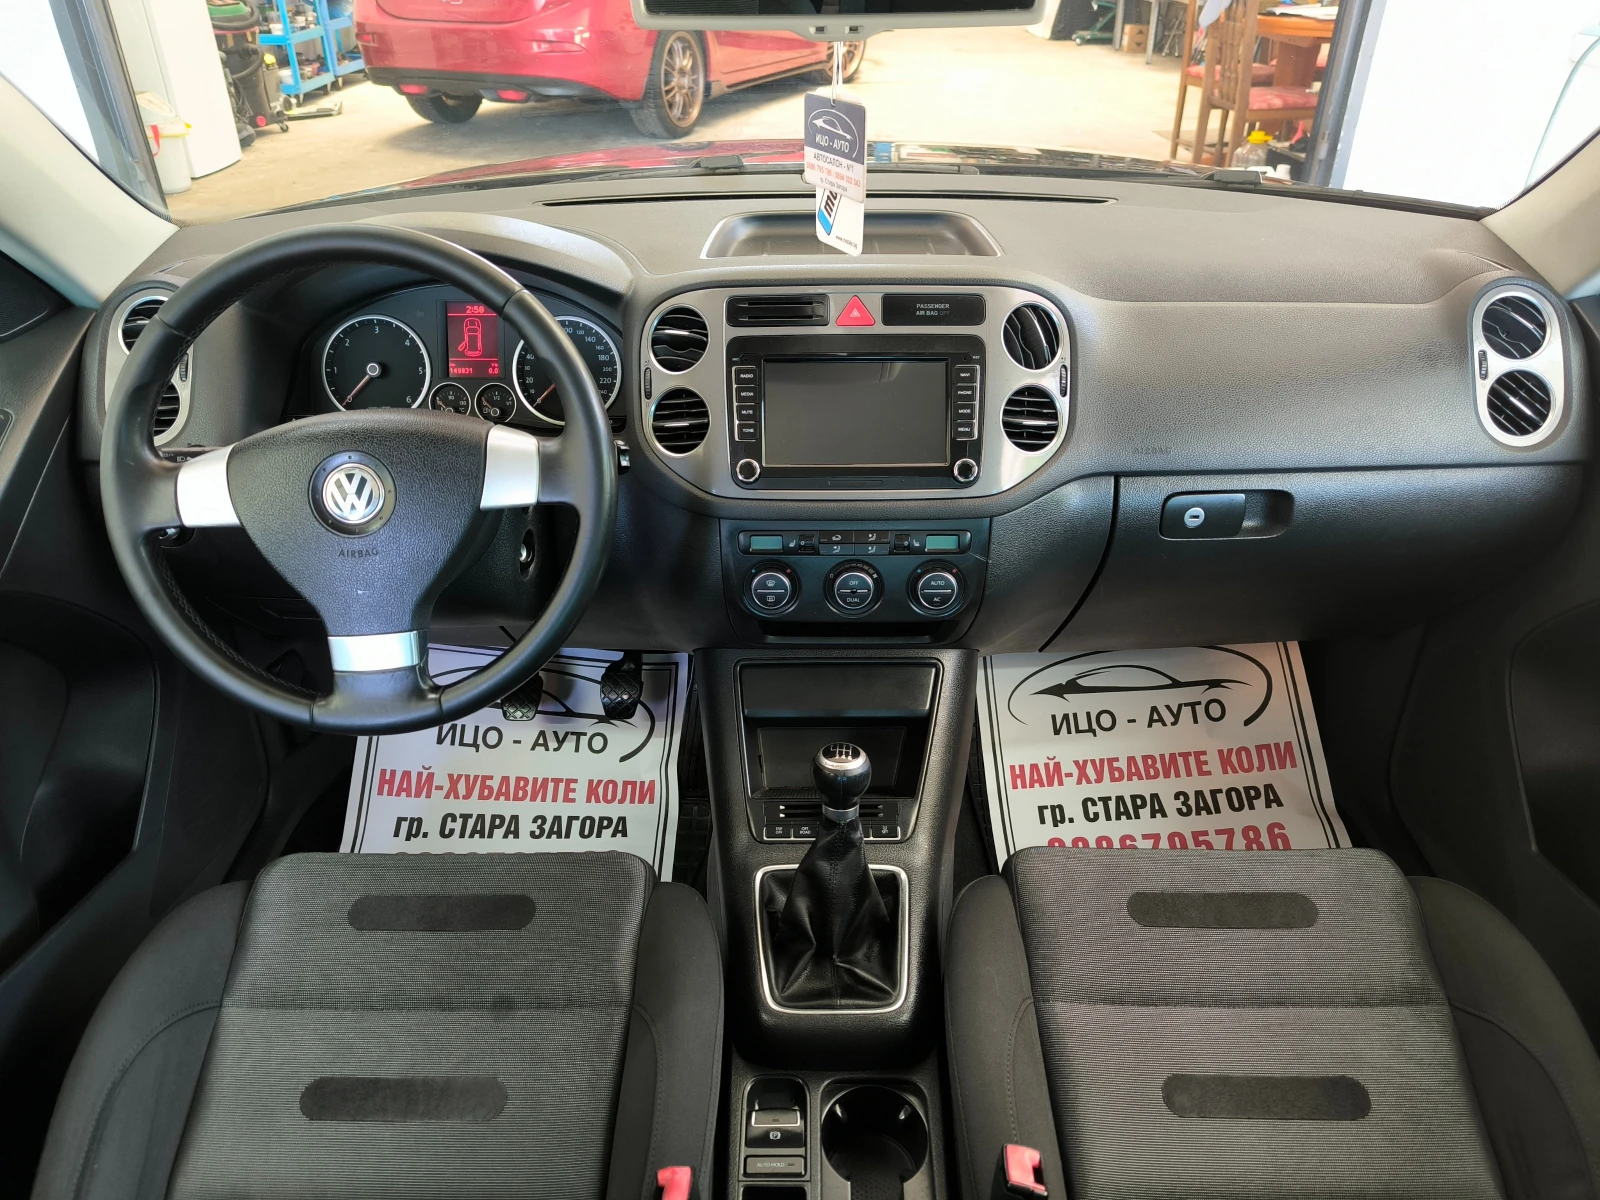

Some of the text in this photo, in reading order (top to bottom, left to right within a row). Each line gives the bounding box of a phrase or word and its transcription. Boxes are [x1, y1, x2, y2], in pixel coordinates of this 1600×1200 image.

[815, 133, 829, 147] ИЦО
[833, 138, 850, 153] АУТО
[814, 153, 843, 169] АВТОСАЛОН
[466, 306, 484, 314] 2:58
[374, 326, 379, 334] 3
[338, 549, 379, 559] AIRBAG
[1051, 709, 1117, 738] ИЦО
[1146, 698, 1227, 728] АУТО
[436, 723, 504, 753] ИЦО
[530, 729, 609, 754] АУТО
[1009, 740, 1298, 790] НАЙ-ХУБАВИТЕ КОЛИ
[376, 764, 656, 805] НАЙ-ХУБАВИТЕ КОЛИ
[1038, 783, 1284, 828] гр. СТАРА ЗАГОРА
[393, 813, 628, 841] гр. СТАРА ЗАГОРА
